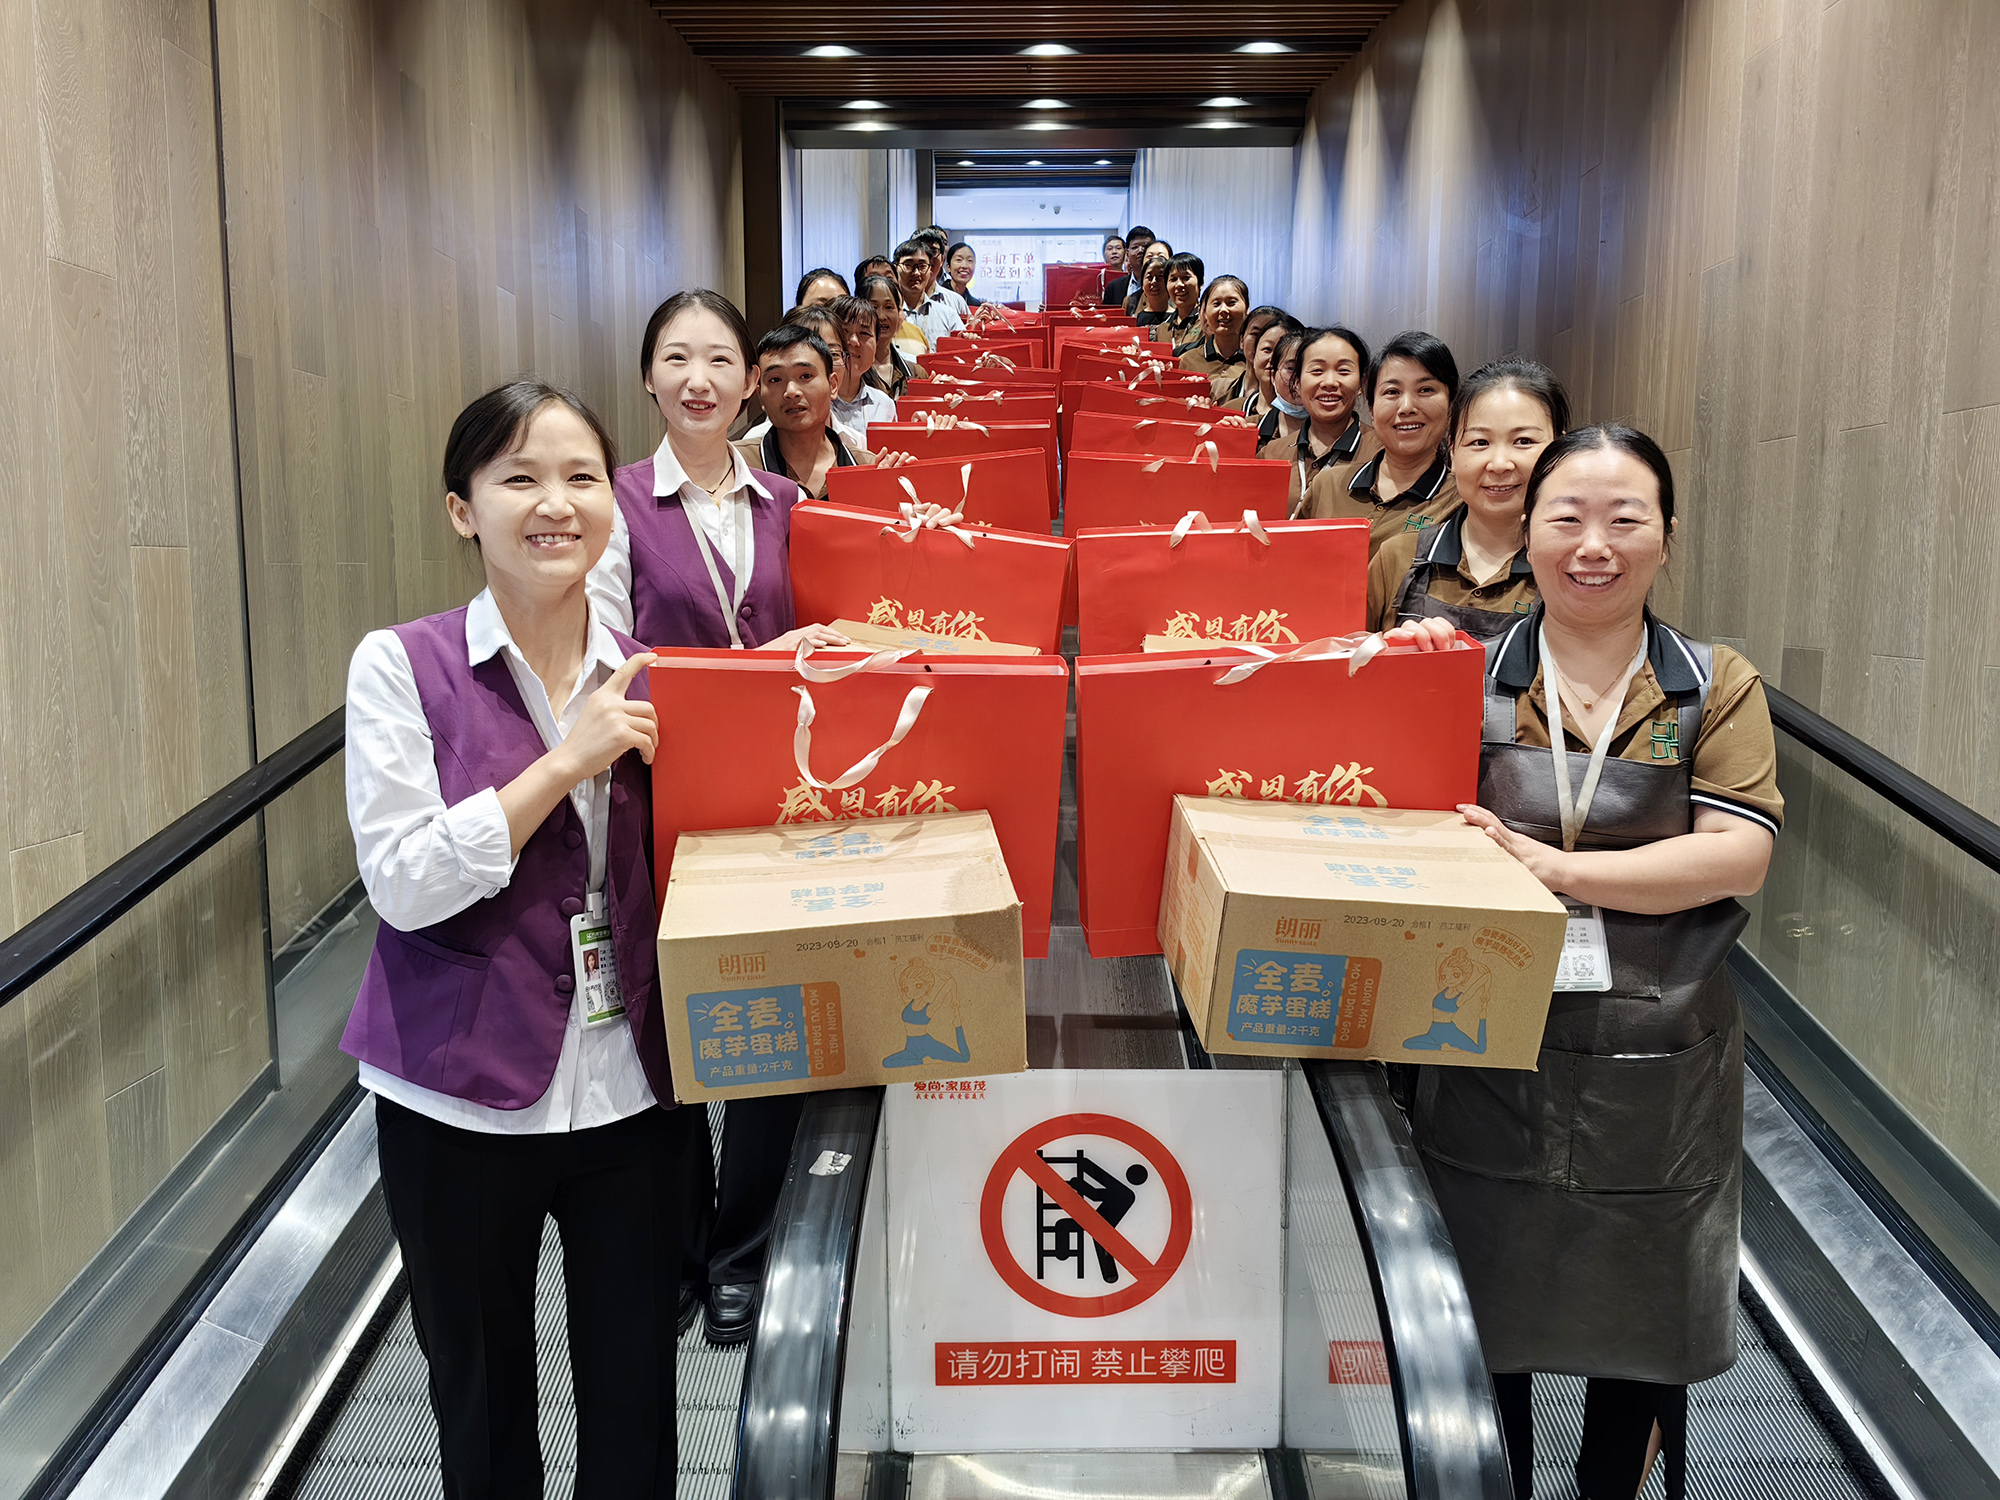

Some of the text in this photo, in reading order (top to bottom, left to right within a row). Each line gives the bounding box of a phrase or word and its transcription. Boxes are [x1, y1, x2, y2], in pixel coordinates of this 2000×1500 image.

[1275, 915, 1323, 940] 朗丽
[1343, 915, 1405, 928] 2023/09/20
[796, 938, 859, 952] 2023/09/20
[718, 951, 766, 976] 朗丽
[1254, 960, 1324, 993] 全麦
[708, 997, 783, 1033] 全麦
[1236, 993, 1332, 1020] 魔芋蛋糕
[1339, 963, 1361, 1042] MO YU DAN GAO
[1357, 978, 1374, 1030] QUAN MAI
[809, 989, 825, 1070] MO YU DAN GAO
[825, 1002, 839, 1055] QUAN MAI
[1241, 1021, 1321, 1038] 产品重量:2千克
[699, 1030, 799, 1060] 魔芋蛋糕
[709, 1060, 793, 1078] 产品重量:2千克
[948, 1347, 1226, 1380] 请勿打闹 禁止攀爬
